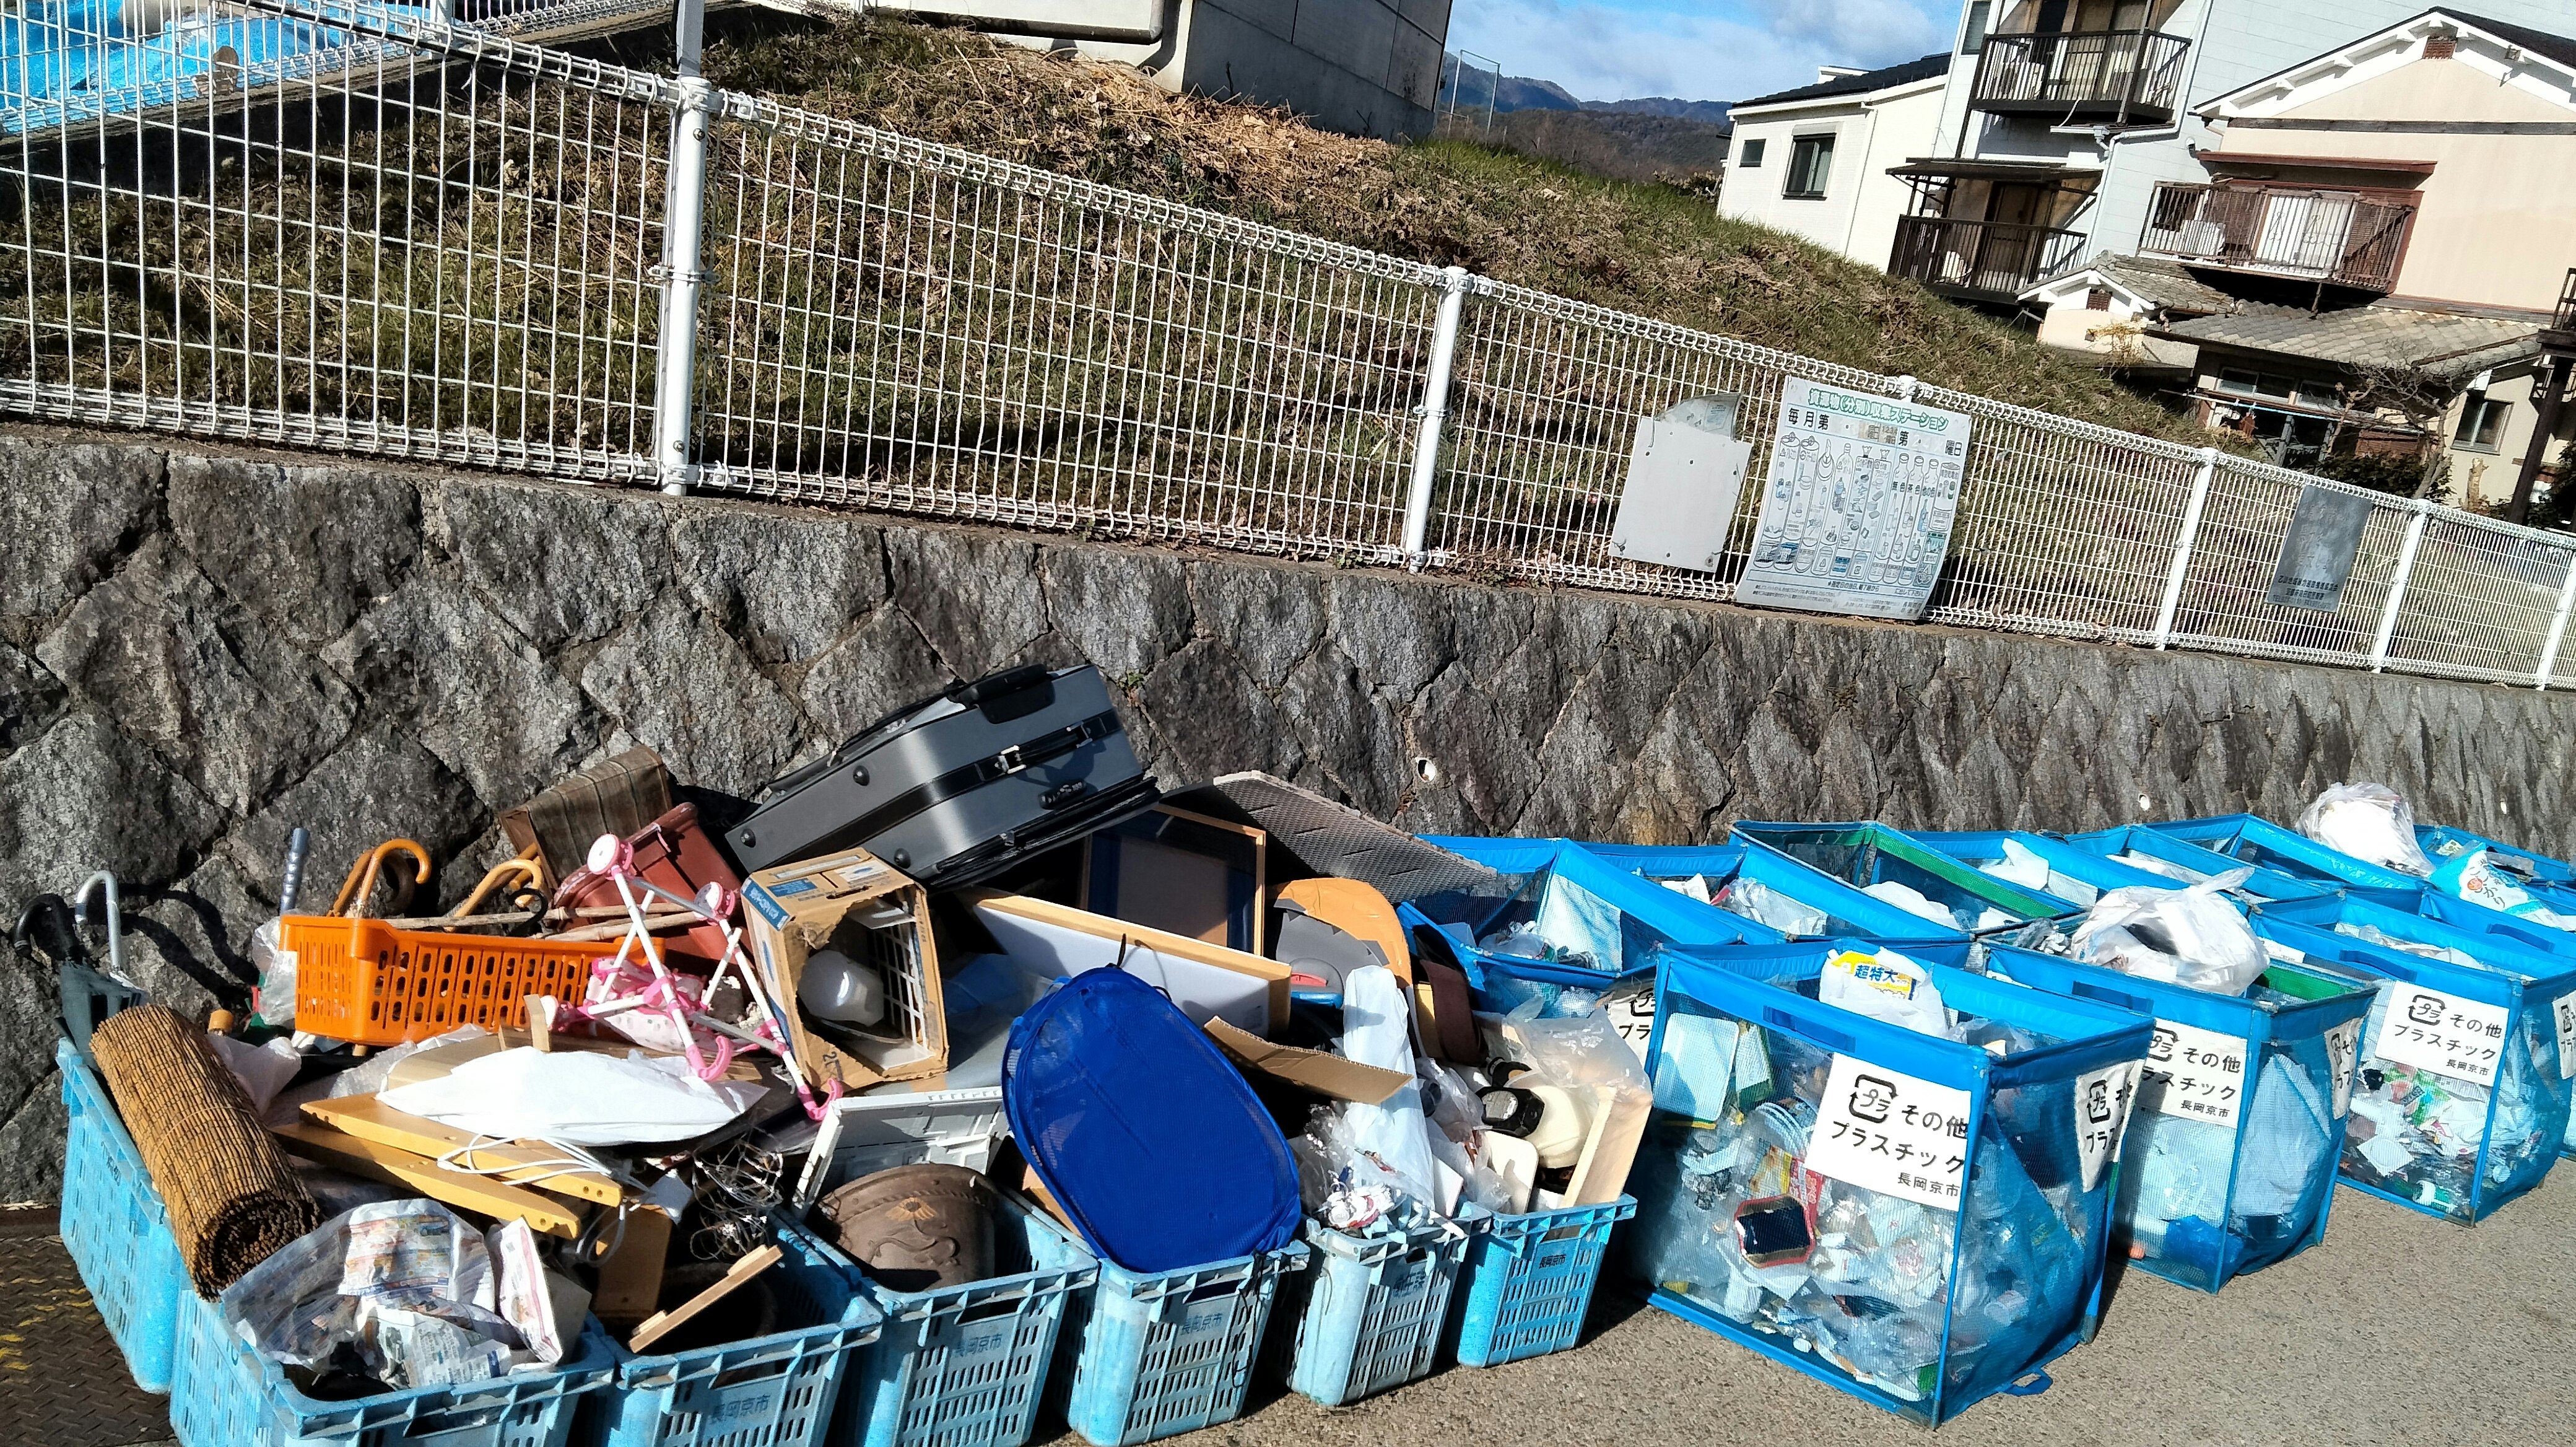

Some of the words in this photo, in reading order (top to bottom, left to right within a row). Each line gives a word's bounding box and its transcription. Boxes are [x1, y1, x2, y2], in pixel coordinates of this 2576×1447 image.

[1808, 388, 1949, 431] 資源物(分別)収集ステーション
[1854, 964, 1899, 984] 超特大
[2450, 1013, 2502, 1039] その他
[2394, 1024, 2496, 1060] プラスチック
[2183, 1047, 2241, 1073] その他
[2445, 1059, 2489, 1076] 長岡京市
[2180, 1099, 2230, 1118] 長岡京市
[1902, 1104, 1969, 1140] その他
[1832, 1120, 1965, 1174] プラスチック
[1897, 1172, 1961, 1197] 長岡京市
